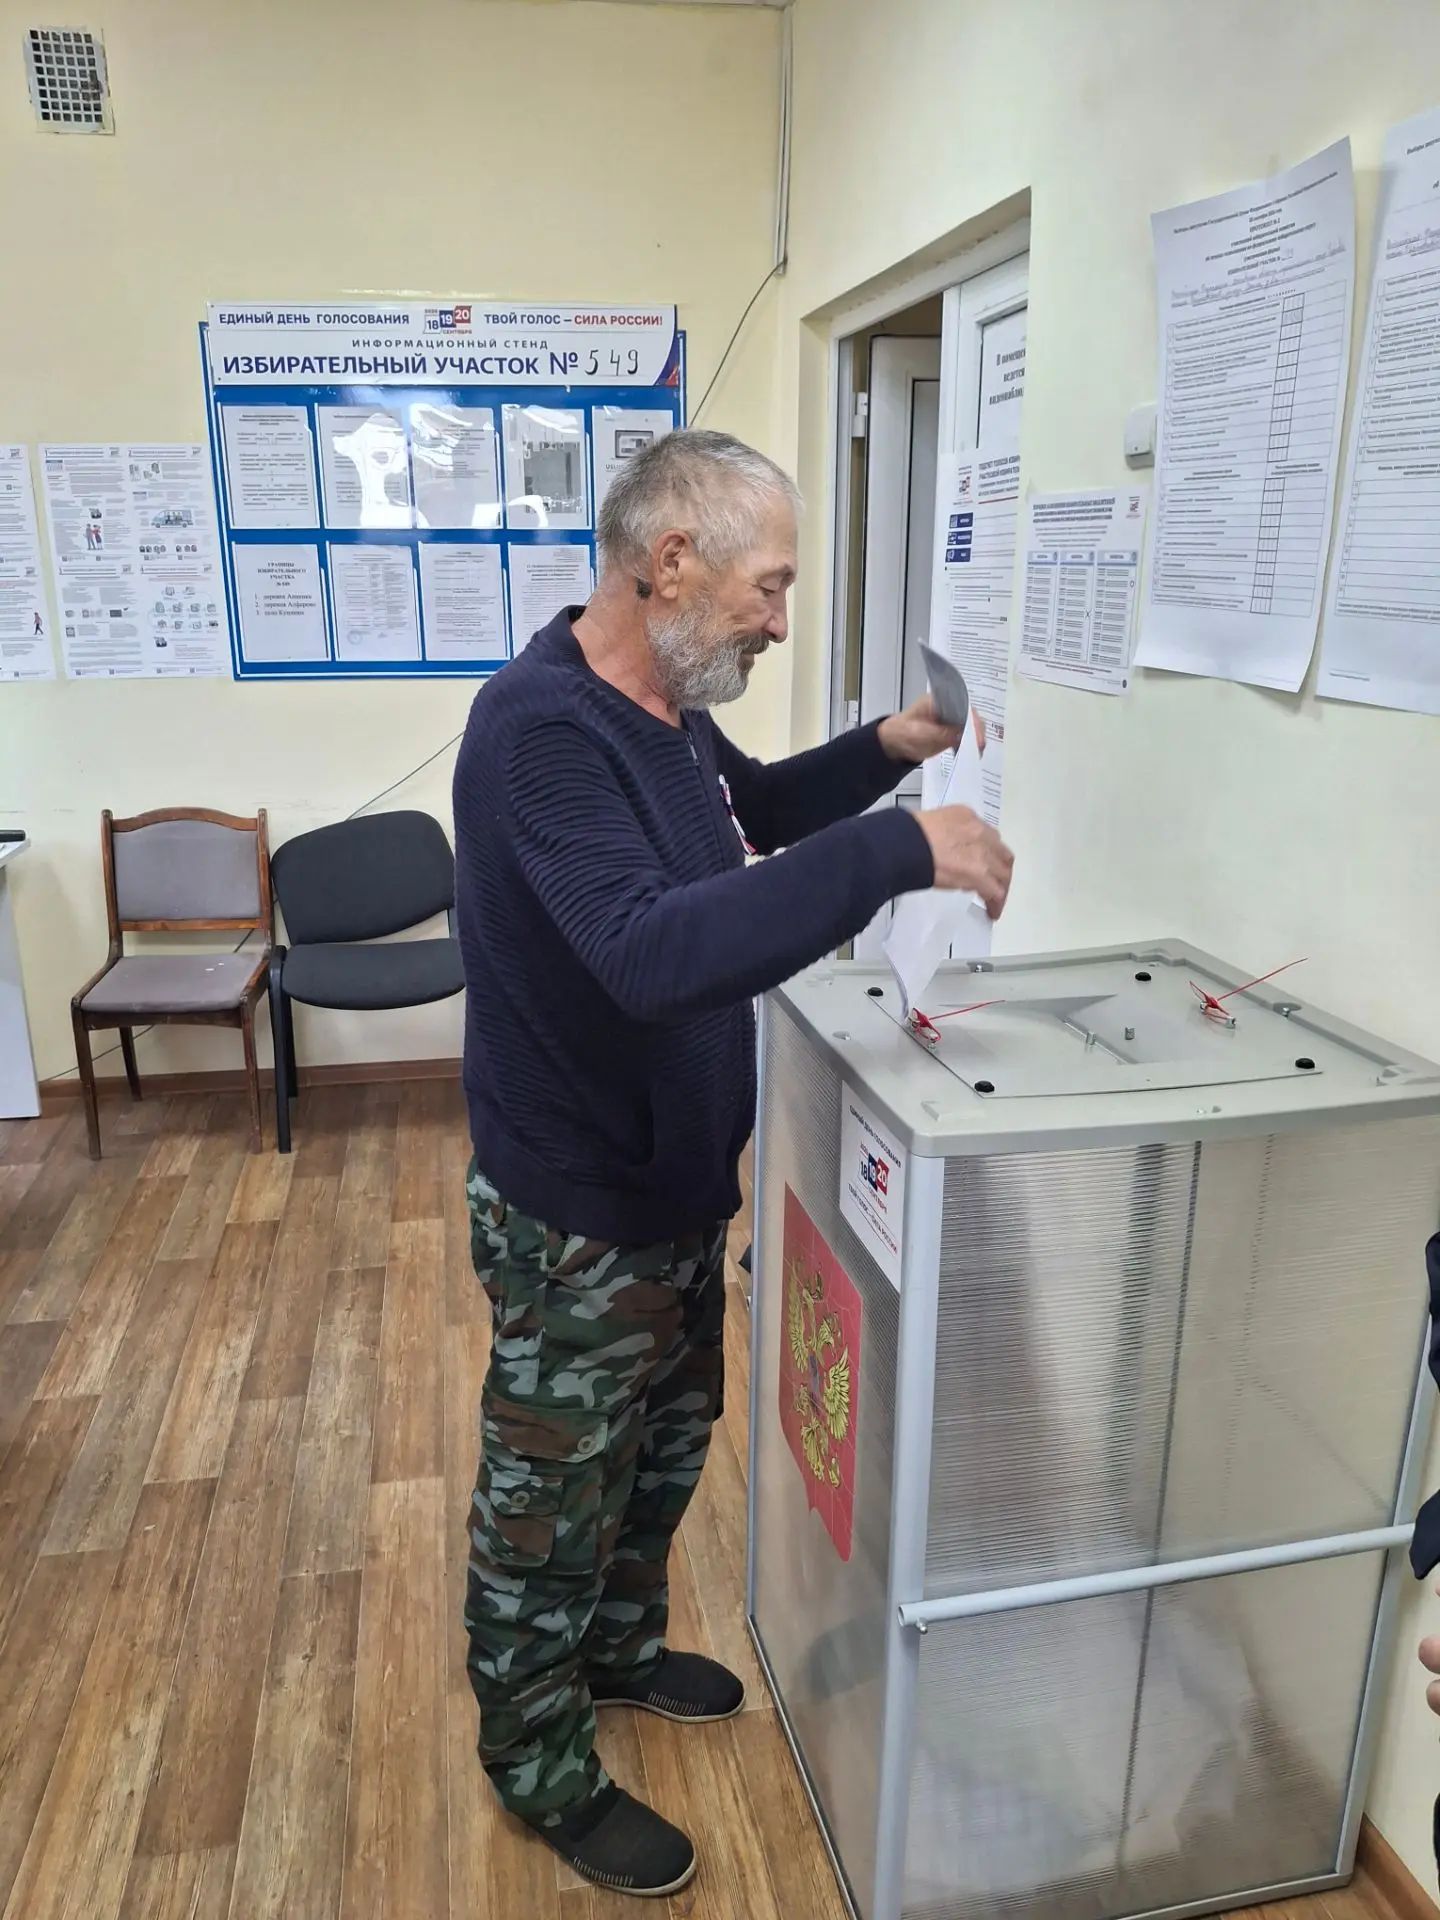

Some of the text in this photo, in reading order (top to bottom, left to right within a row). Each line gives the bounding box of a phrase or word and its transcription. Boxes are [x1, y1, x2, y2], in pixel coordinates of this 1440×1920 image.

[219, 312, 410, 325] ЕДИНЫЙ ДЕНЬ ГОЛОСОВАНИЯ
[427, 309, 470, 330] 18 19 20
[484, 312, 517, 325] ТВОЙ
[521, 314, 561, 325] ГОЛОС
[574, 315, 607, 326] СИЛА
[611, 315, 663, 326] РОССИИ!
[352, 339, 548, 350] ИНФОРМАЦИОННЫЙ СТЕНД
[224, 352, 579, 375] ИЗБИРАТЕЛЬНЫЙ УЧАСТОК №
[860, 1160, 887, 1188] 18 19 20
